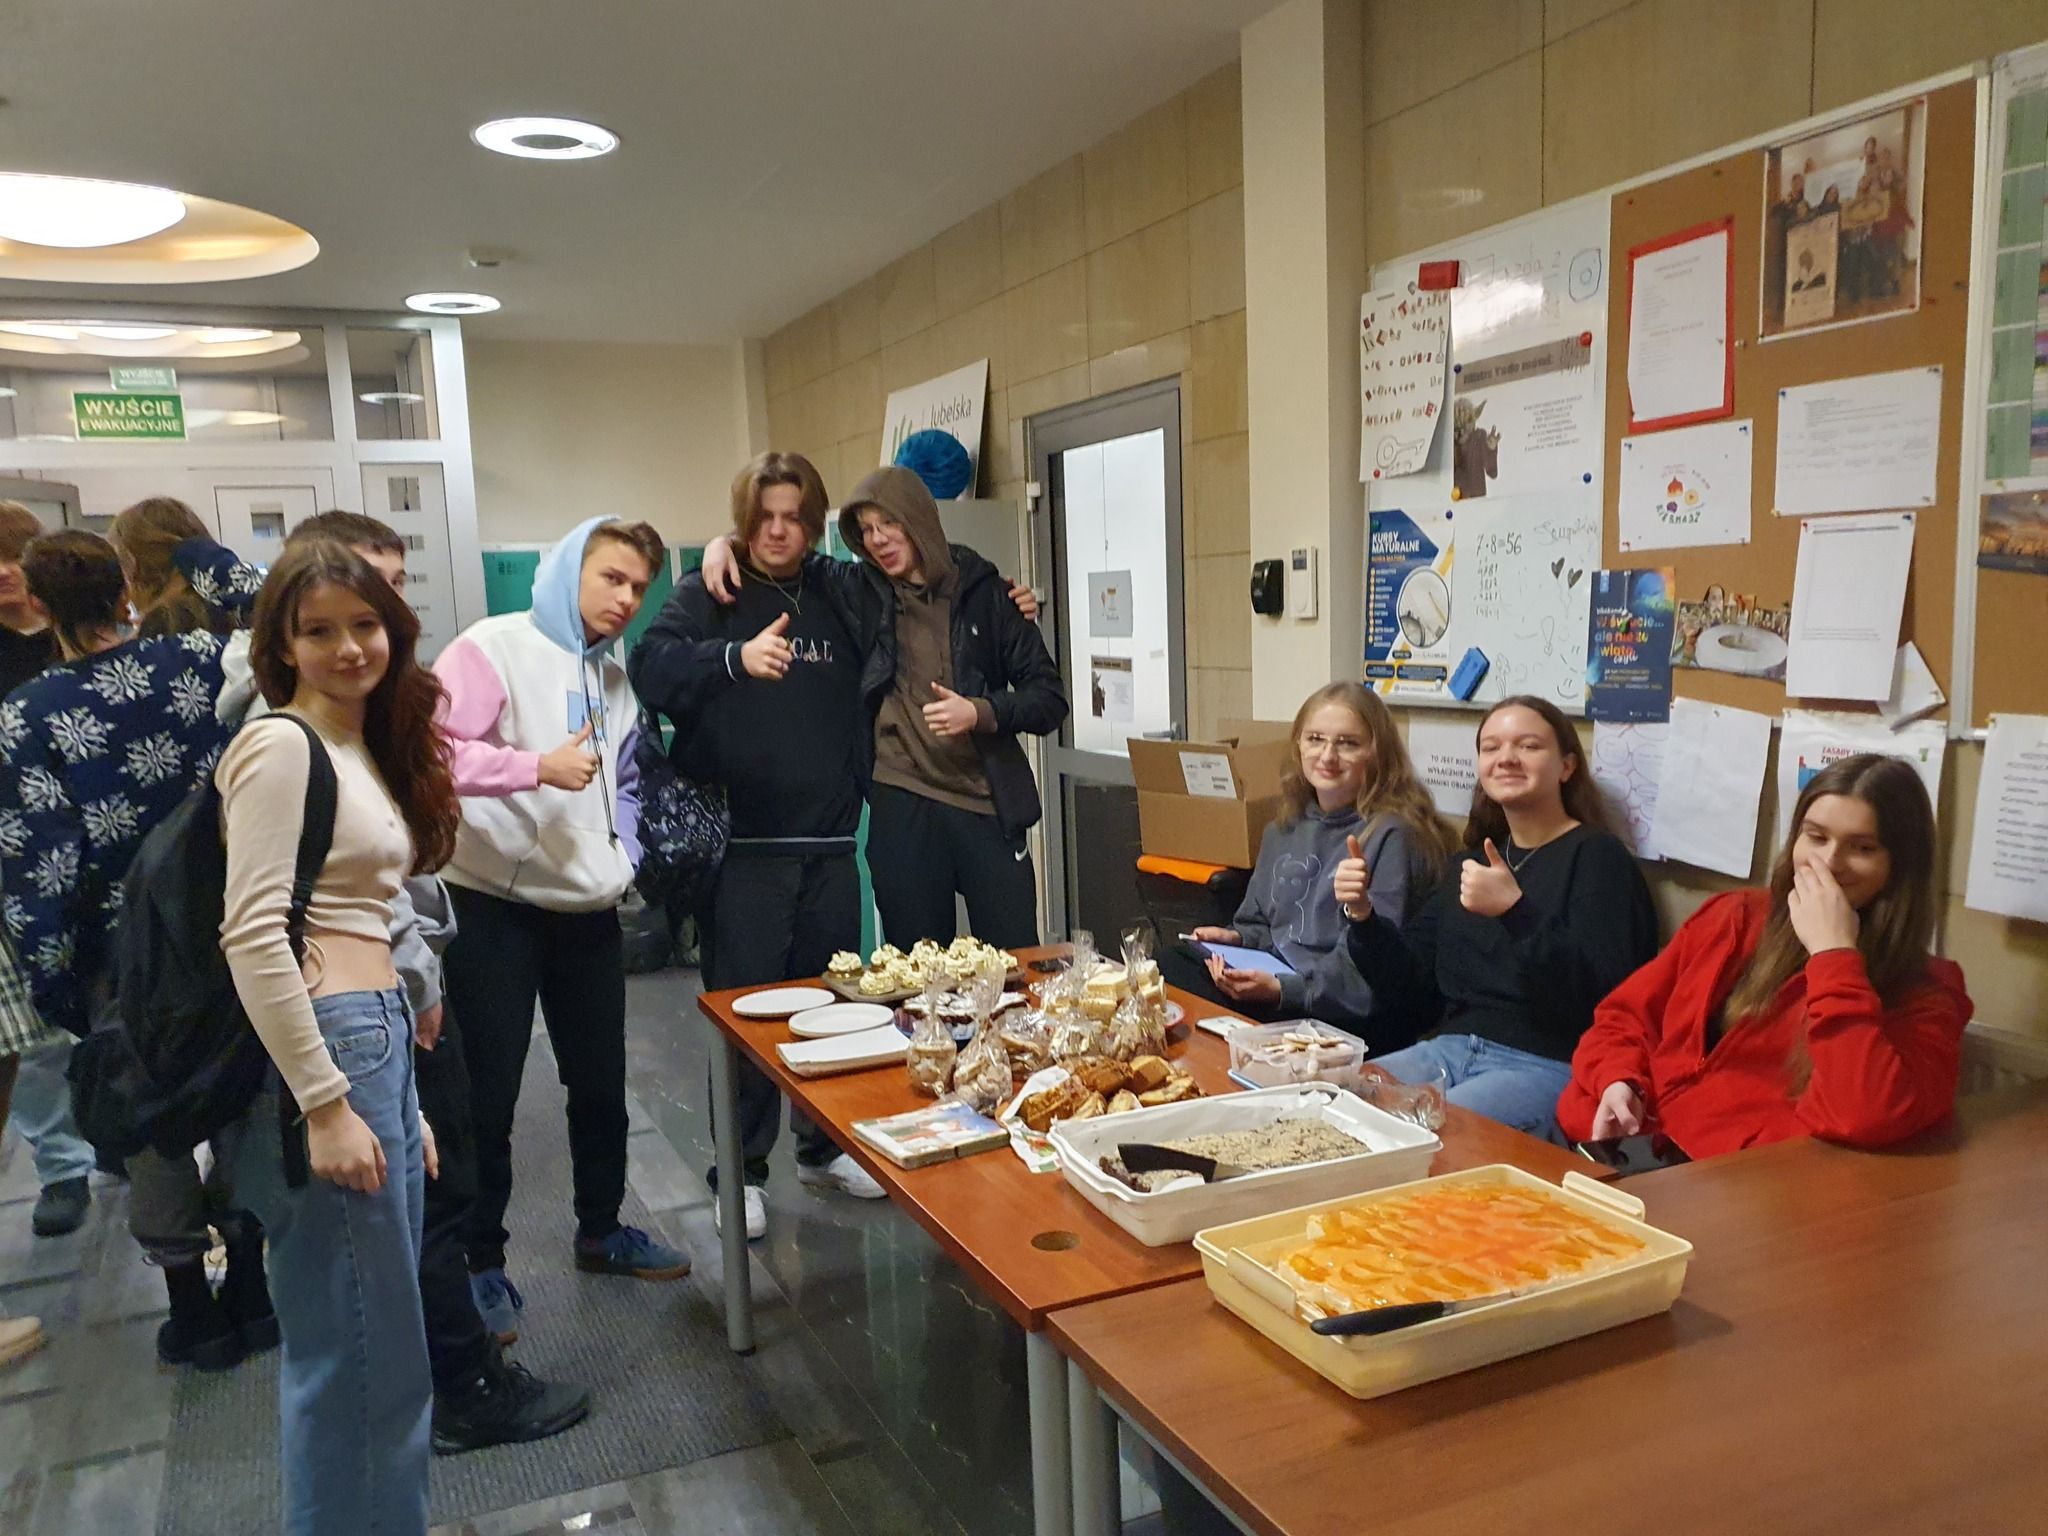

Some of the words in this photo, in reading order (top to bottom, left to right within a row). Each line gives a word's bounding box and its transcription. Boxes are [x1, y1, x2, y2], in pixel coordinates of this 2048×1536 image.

[83, 396, 175, 417] WYJŚCIE
[930, 393, 972, 429] lubelska
[80, 419, 181, 432] EWAKUACYJNE
[1371, 540, 1420, 554] MATURALNE
[1822, 746, 1851, 756] ZASADY
[1465, 771, 1476, 779] NA
